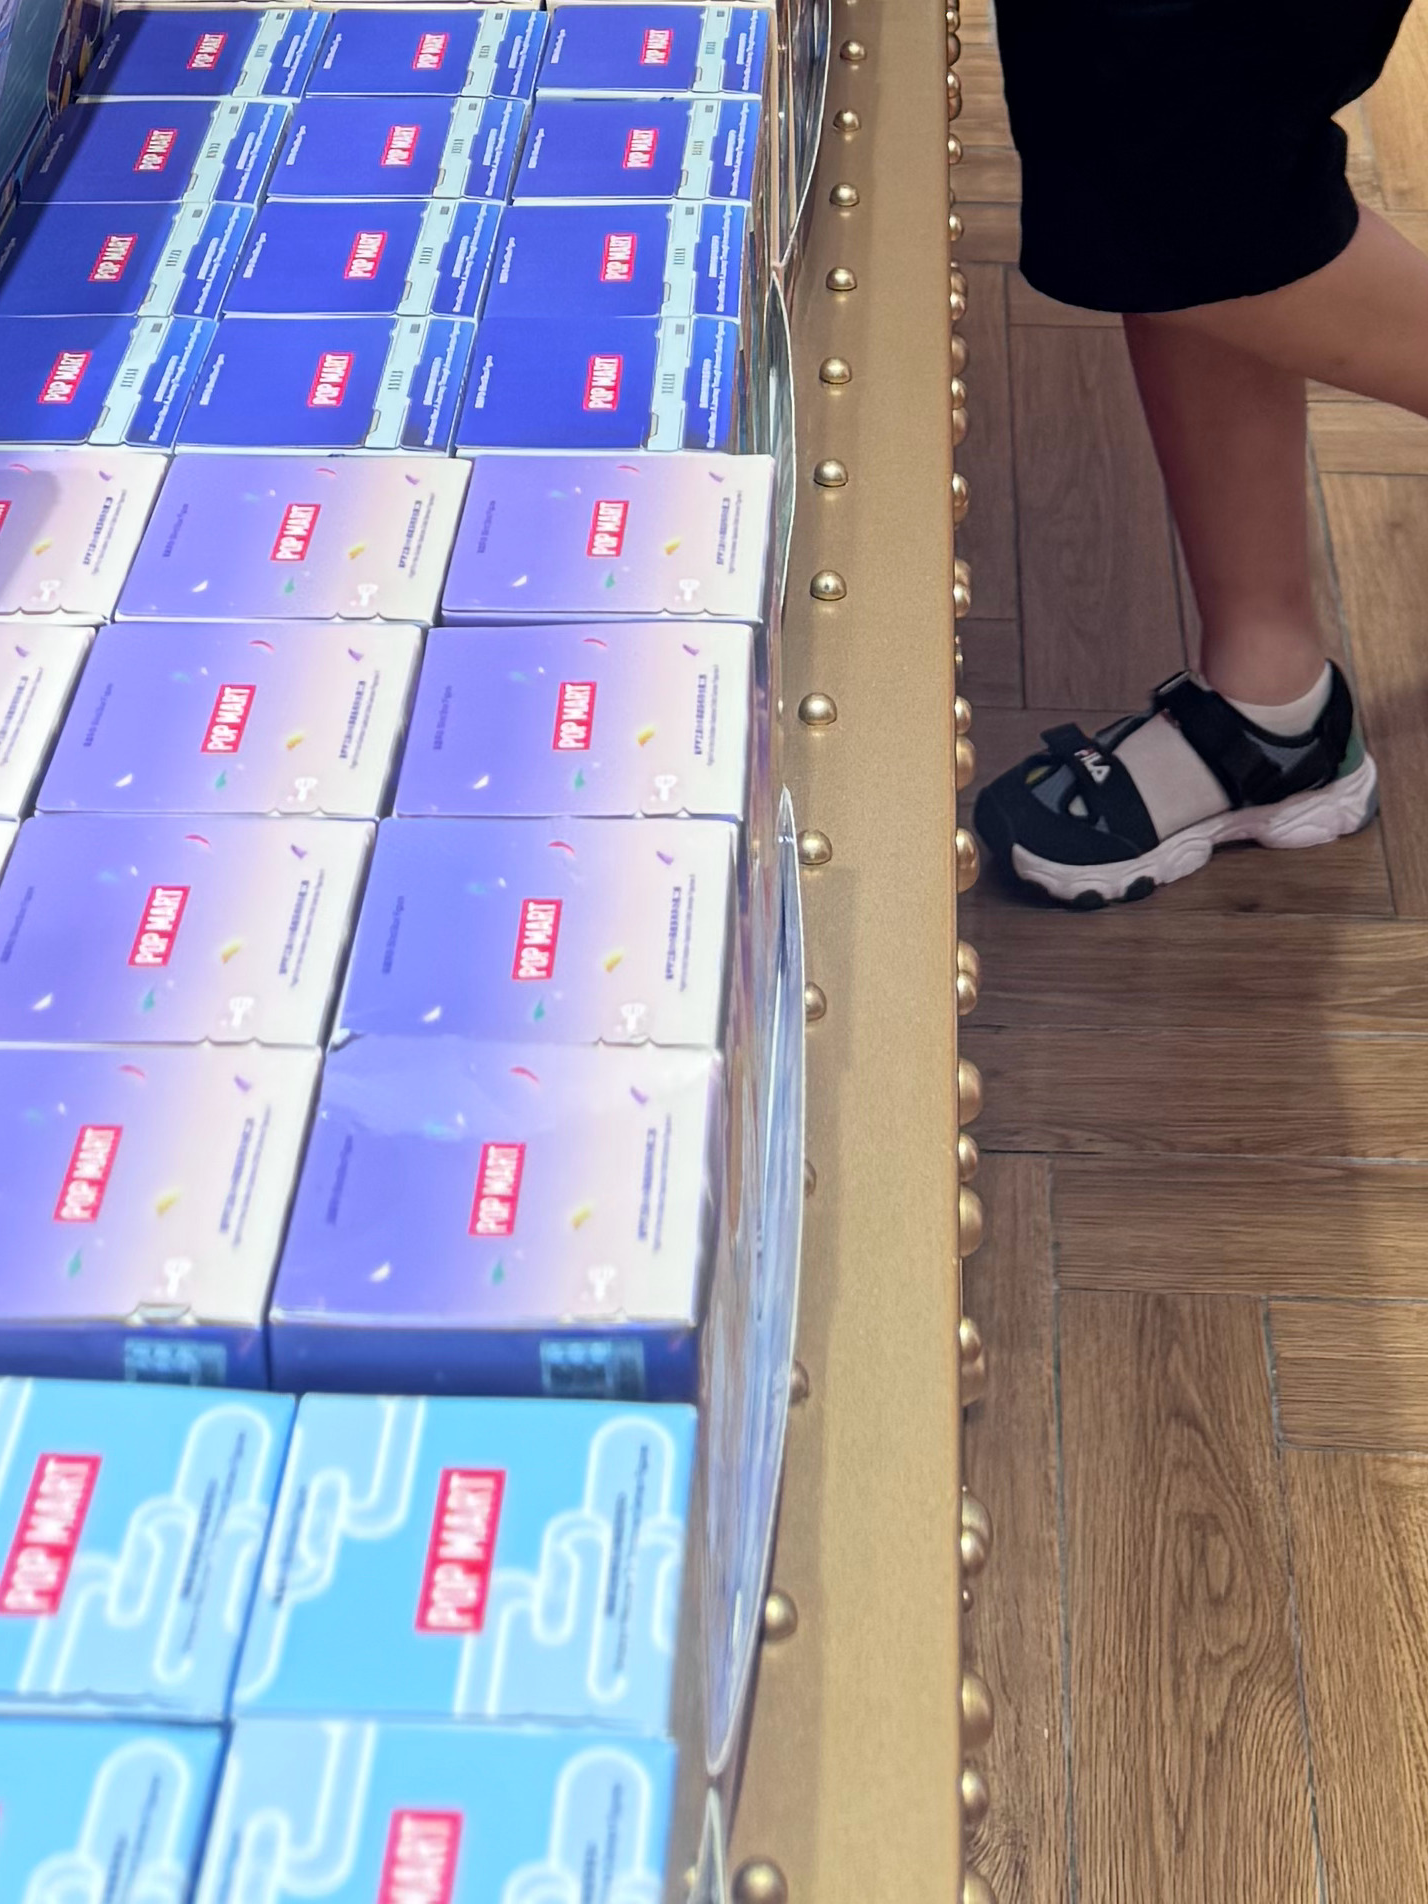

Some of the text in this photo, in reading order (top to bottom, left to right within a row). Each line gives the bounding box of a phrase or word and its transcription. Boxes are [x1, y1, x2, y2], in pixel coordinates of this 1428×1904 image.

[42, 353, 87, 399] POP MART
[311, 356, 350, 403] POP MART
[588, 358, 619, 407] POP MART
[274, 506, 317, 558] POP MART
[590, 502, 625, 554] POP MART
[206, 686, 252, 750] POP MART
[557, 684, 592, 747] POP MART
[133, 888, 186, 963] POP MART
[517, 901, 558, 977] POP MART
[58, 1129, 118, 1218] POP MART
[474, 1146, 521, 1230] POP MART
[2, 1459, 94, 1606] POP MART
[424, 1473, 498, 1624] POP MART
